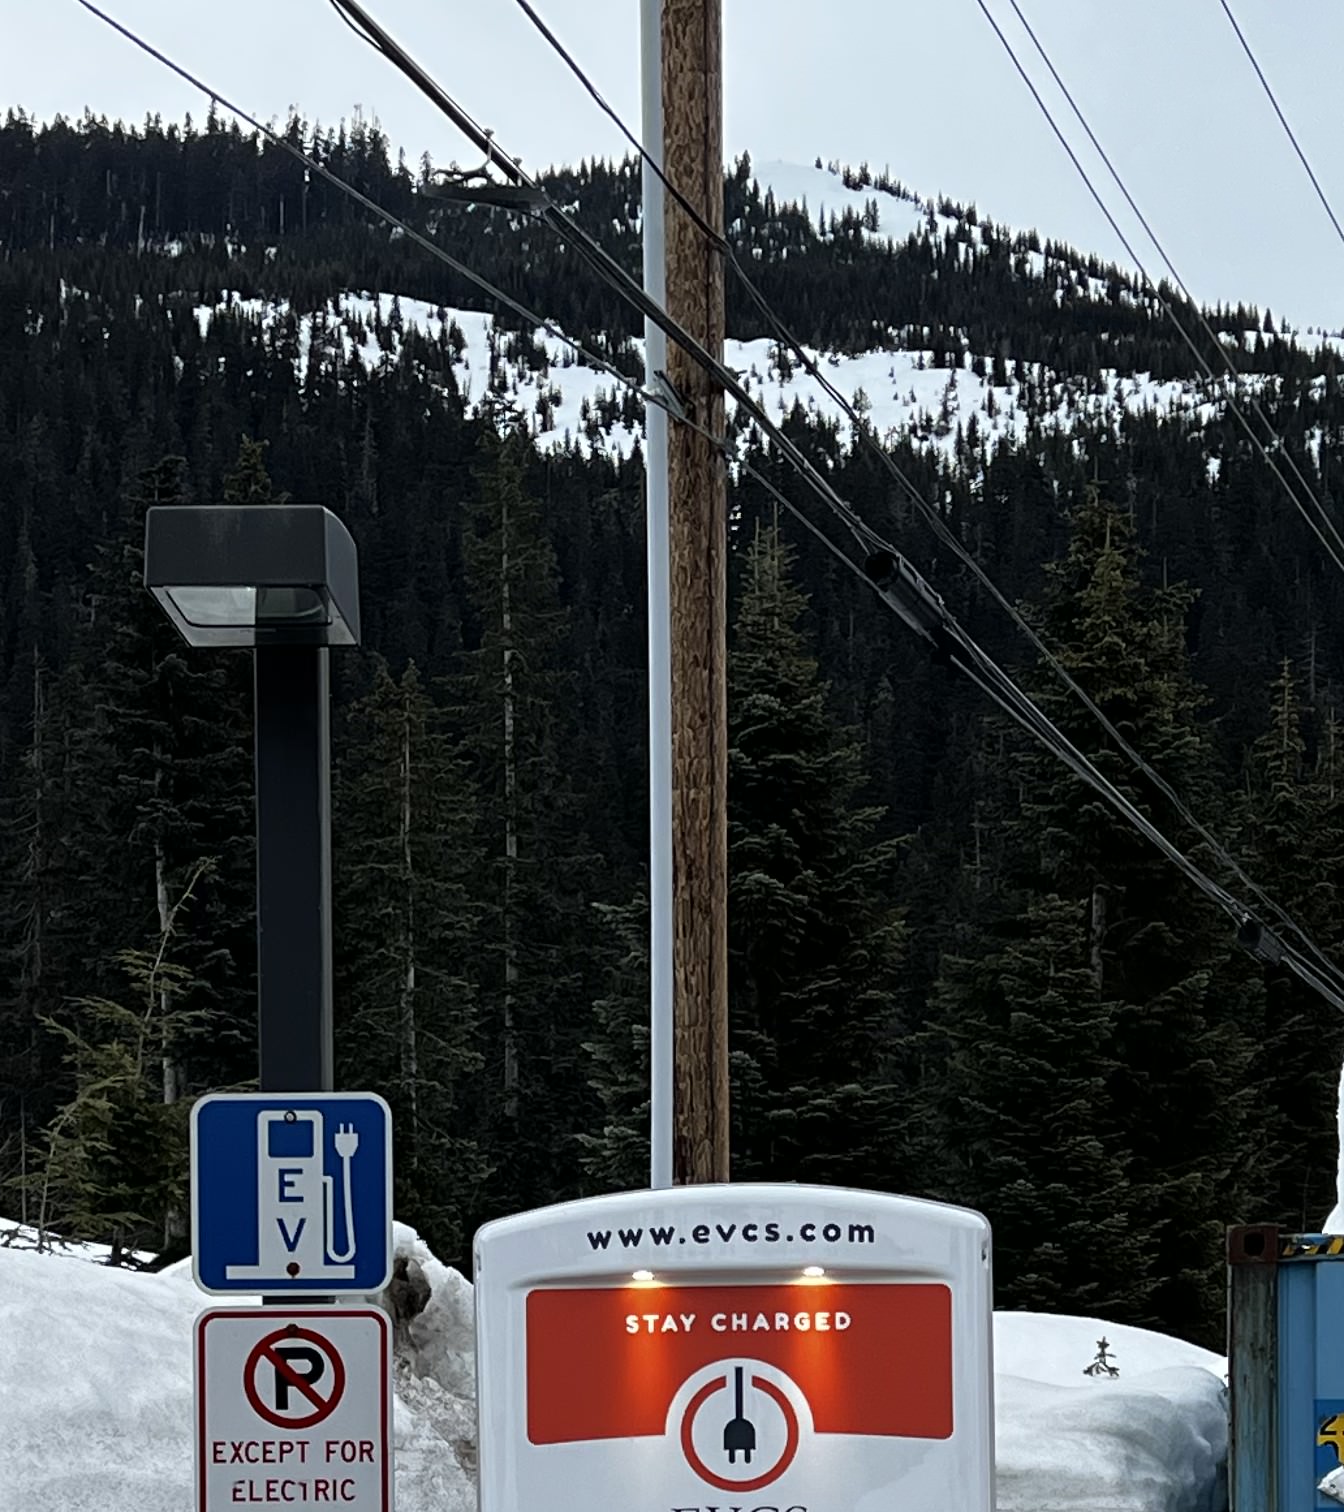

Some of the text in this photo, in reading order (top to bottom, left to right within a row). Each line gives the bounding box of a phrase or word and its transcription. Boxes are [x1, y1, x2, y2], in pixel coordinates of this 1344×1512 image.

[277, 1168, 306, 1253] EV
[586, 1223, 875, 1250] www.evcs.com
[625, 1311, 852, 1334] STAY CHARGED
[212, 1440, 375, 1464] EXCEPT FOR
[232, 1478, 356, 1502] ELECTRIC
